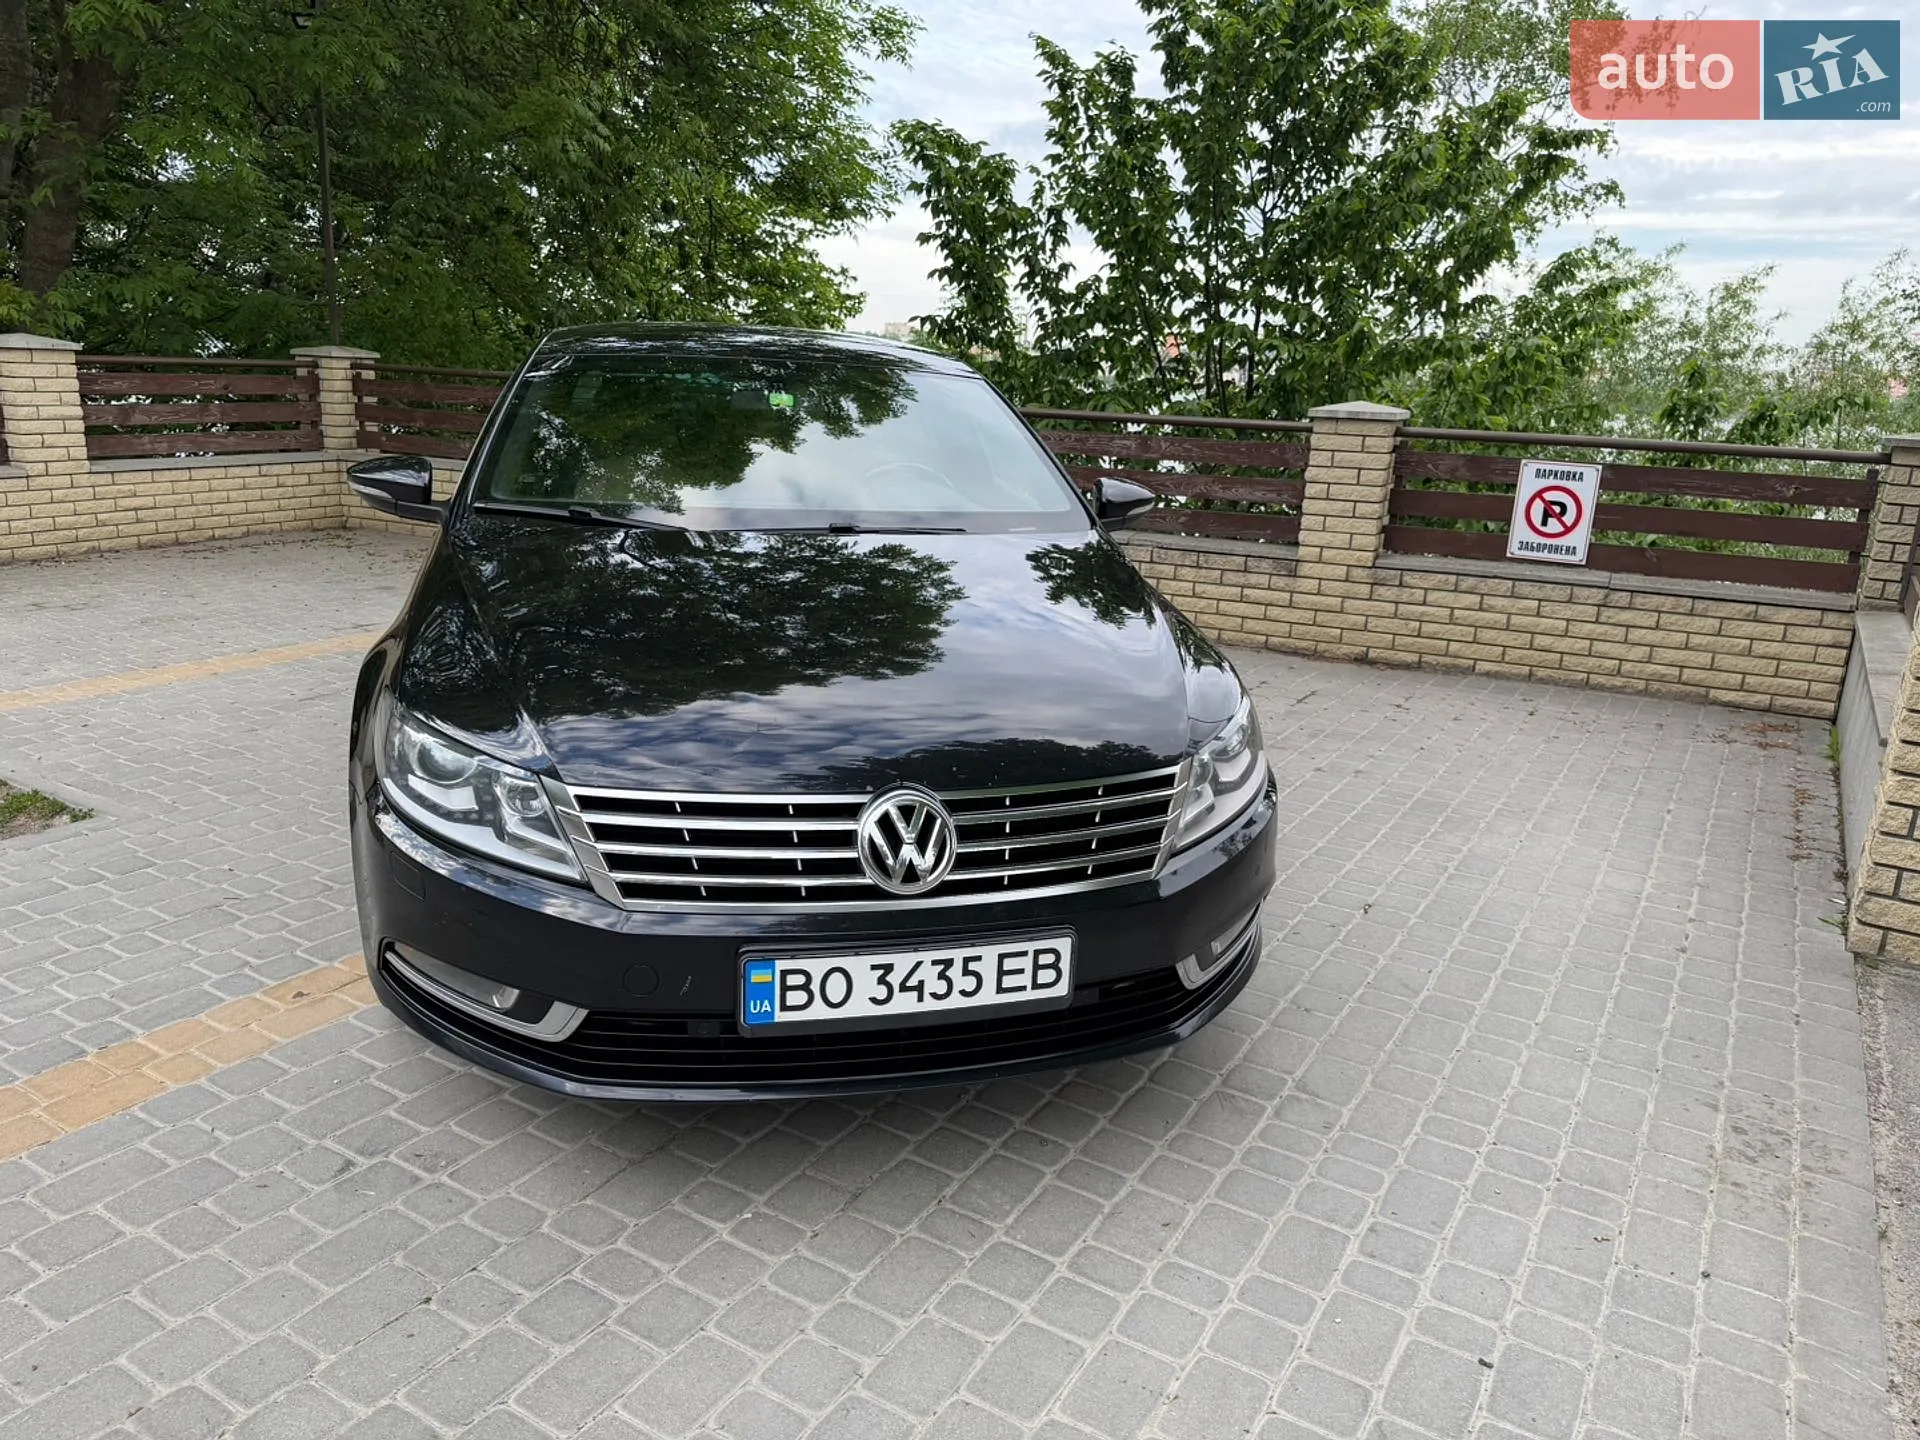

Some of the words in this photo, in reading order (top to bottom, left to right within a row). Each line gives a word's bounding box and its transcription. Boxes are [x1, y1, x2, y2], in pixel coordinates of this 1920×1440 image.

[1534, 468, 1584, 482] ПАРКОВКА
[1517, 541, 1577, 556] ЗАБОРОНЕНА
[779, 966, 853, 1012] BO
[868, 955, 984, 1006] 3435
[995, 947, 1063, 995] EB
[750, 1000, 772, 1014] UA
